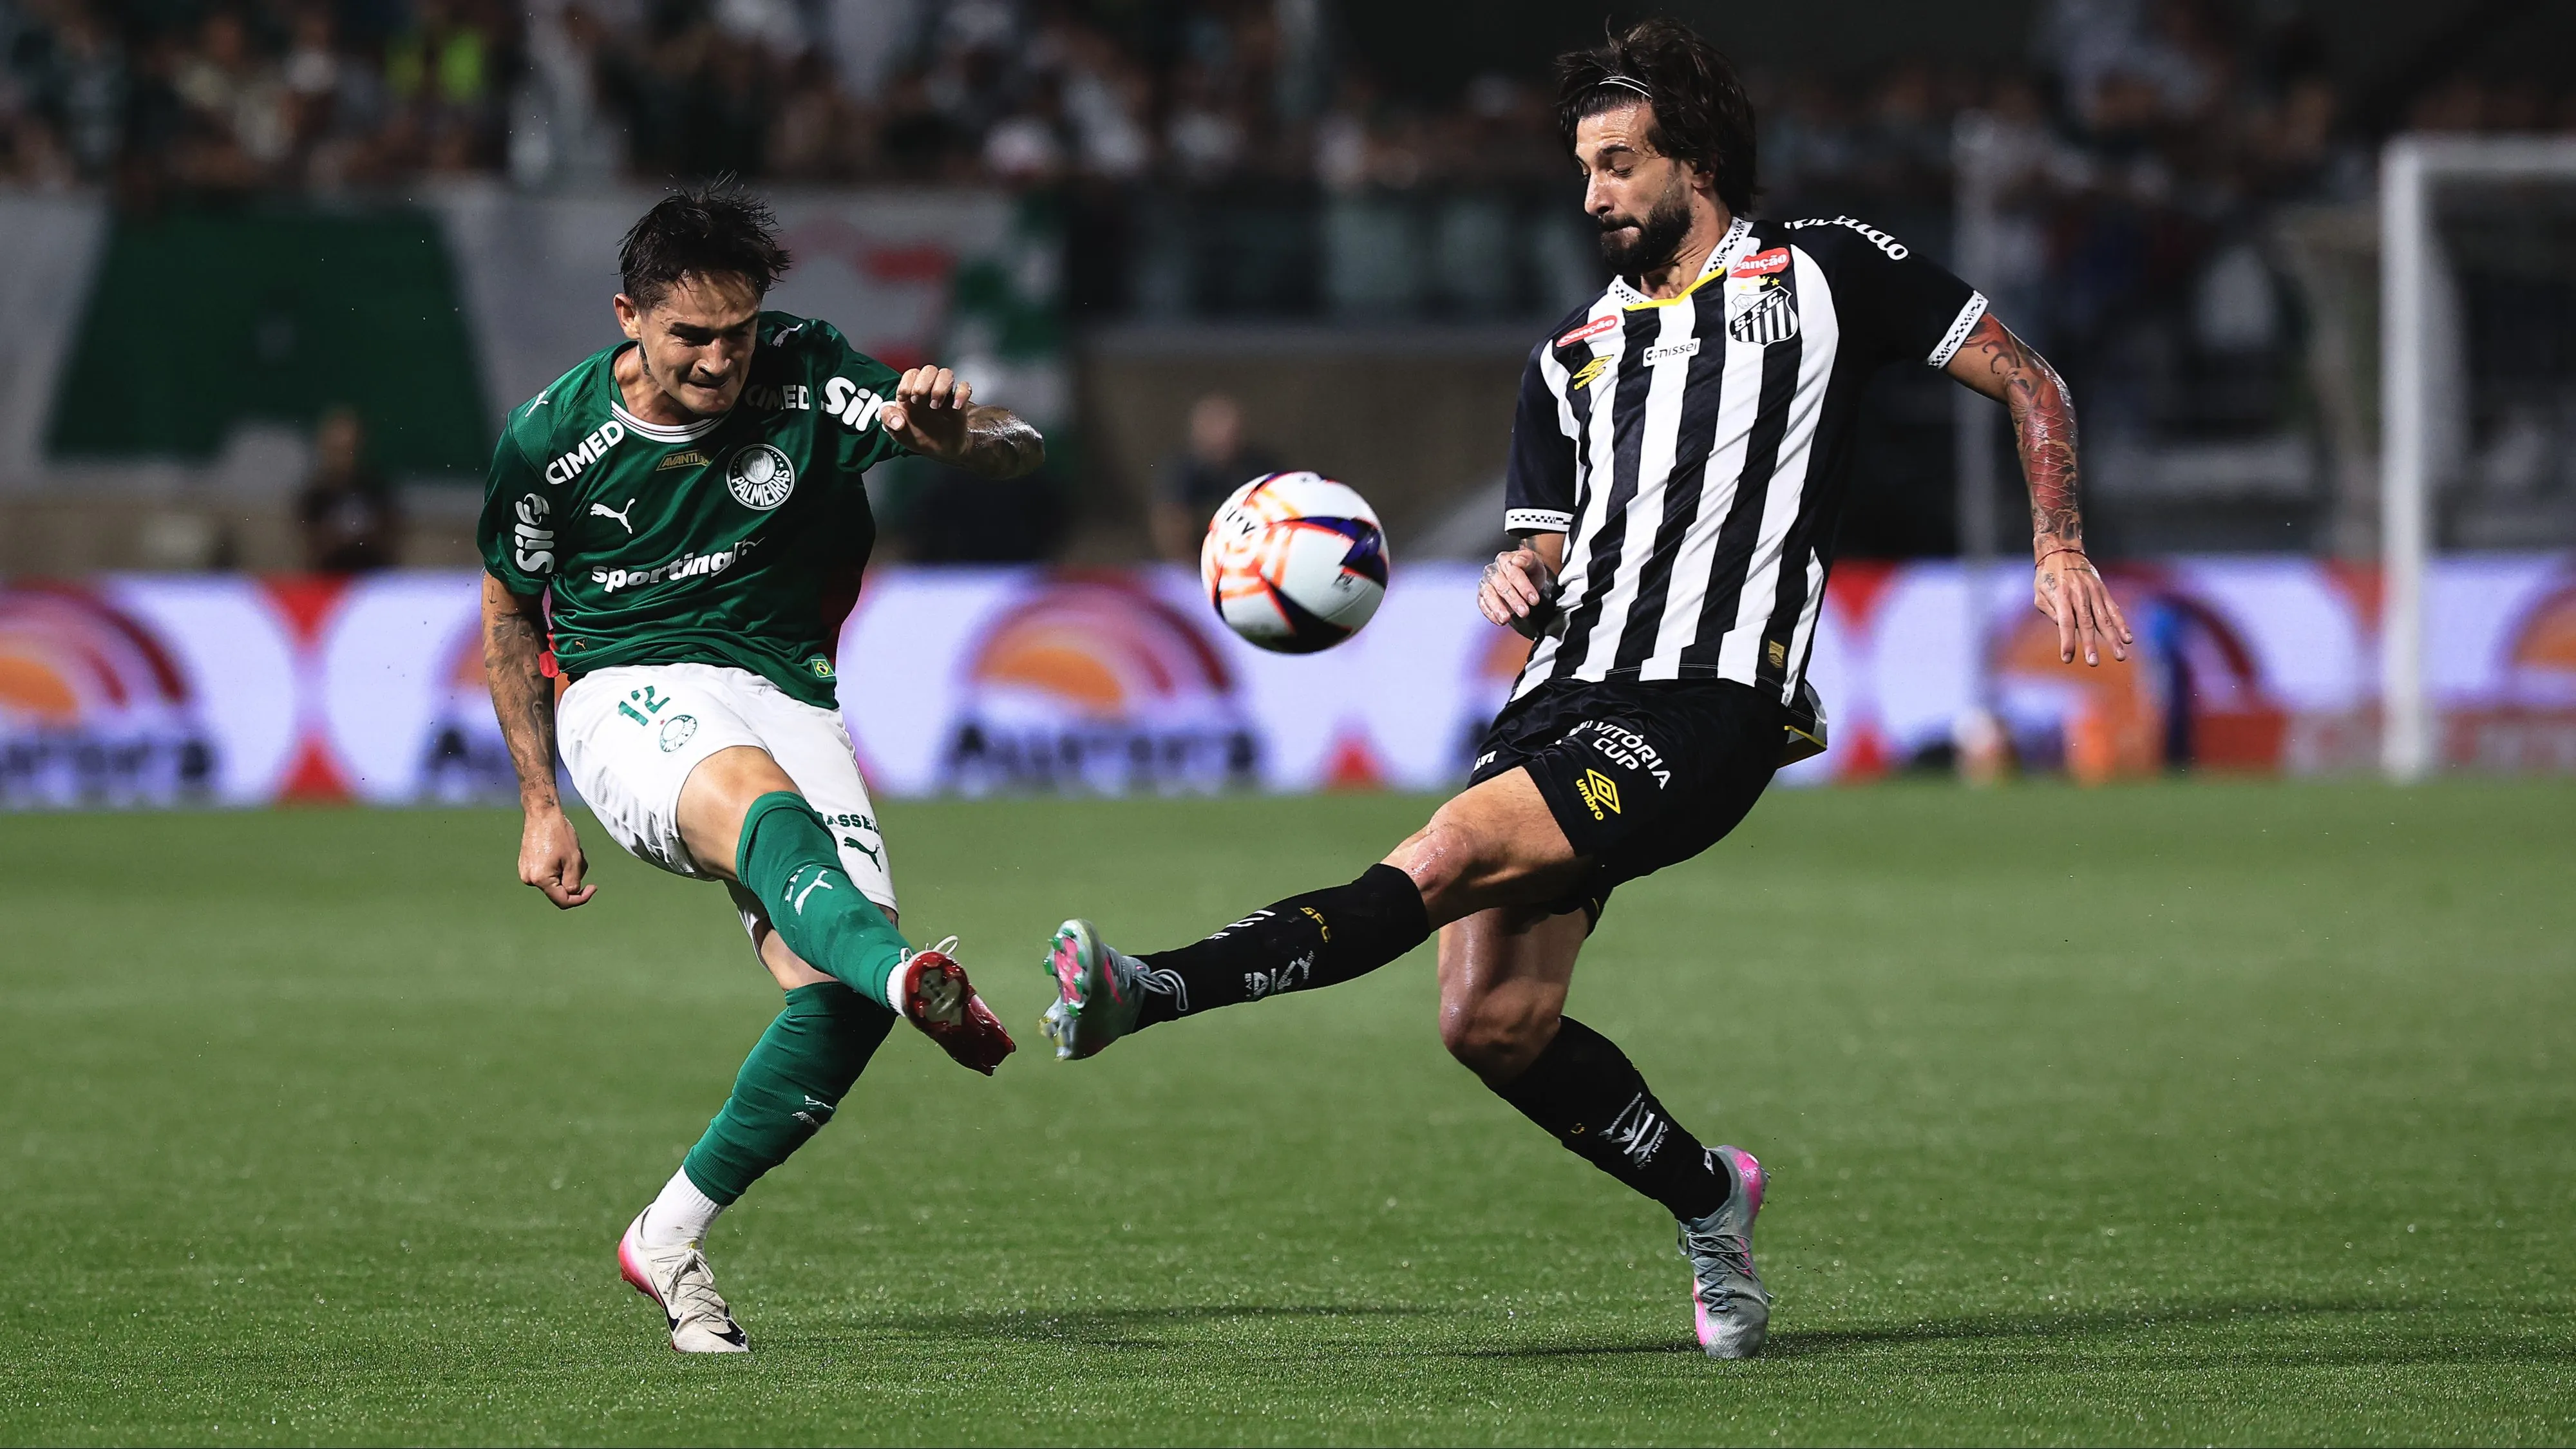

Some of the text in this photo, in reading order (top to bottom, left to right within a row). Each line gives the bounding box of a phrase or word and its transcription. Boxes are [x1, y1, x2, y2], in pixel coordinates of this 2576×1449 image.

[1558, 319, 1615, 343] Canção
[545, 420, 625, 485] CIMED
[661, 452, 699, 468] AVANTI
[731, 469, 791, 507] PALMEIRAS
[618, 685, 671, 727] 12
[1593, 737, 1640, 770] CUP
[1593, 721, 1671, 790] VITÓRIA
[1575, 778, 1604, 820] umbro
